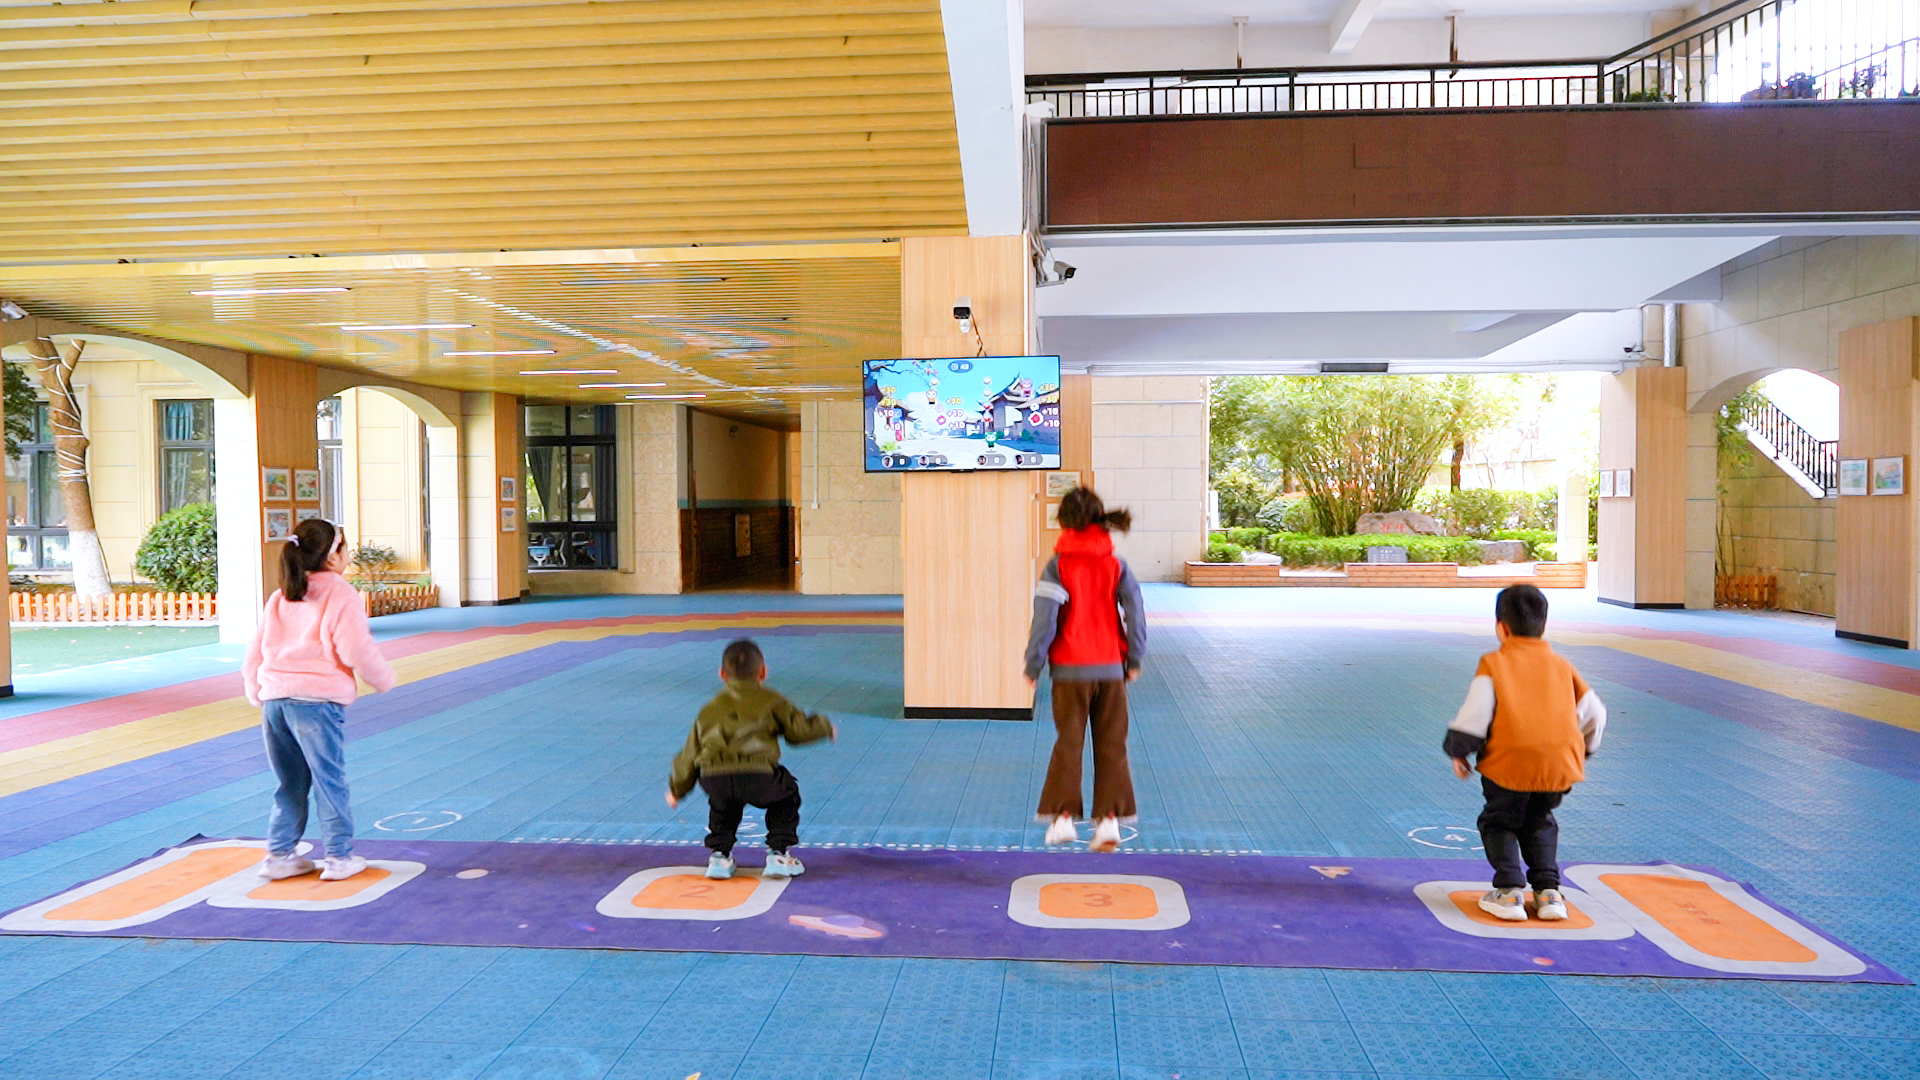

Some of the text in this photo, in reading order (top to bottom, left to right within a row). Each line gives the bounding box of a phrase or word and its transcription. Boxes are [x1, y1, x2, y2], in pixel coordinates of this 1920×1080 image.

[1043, 420, 1060, 428] +10
[677, 884, 716, 898] 2
[1083, 893, 1113, 907] 3
